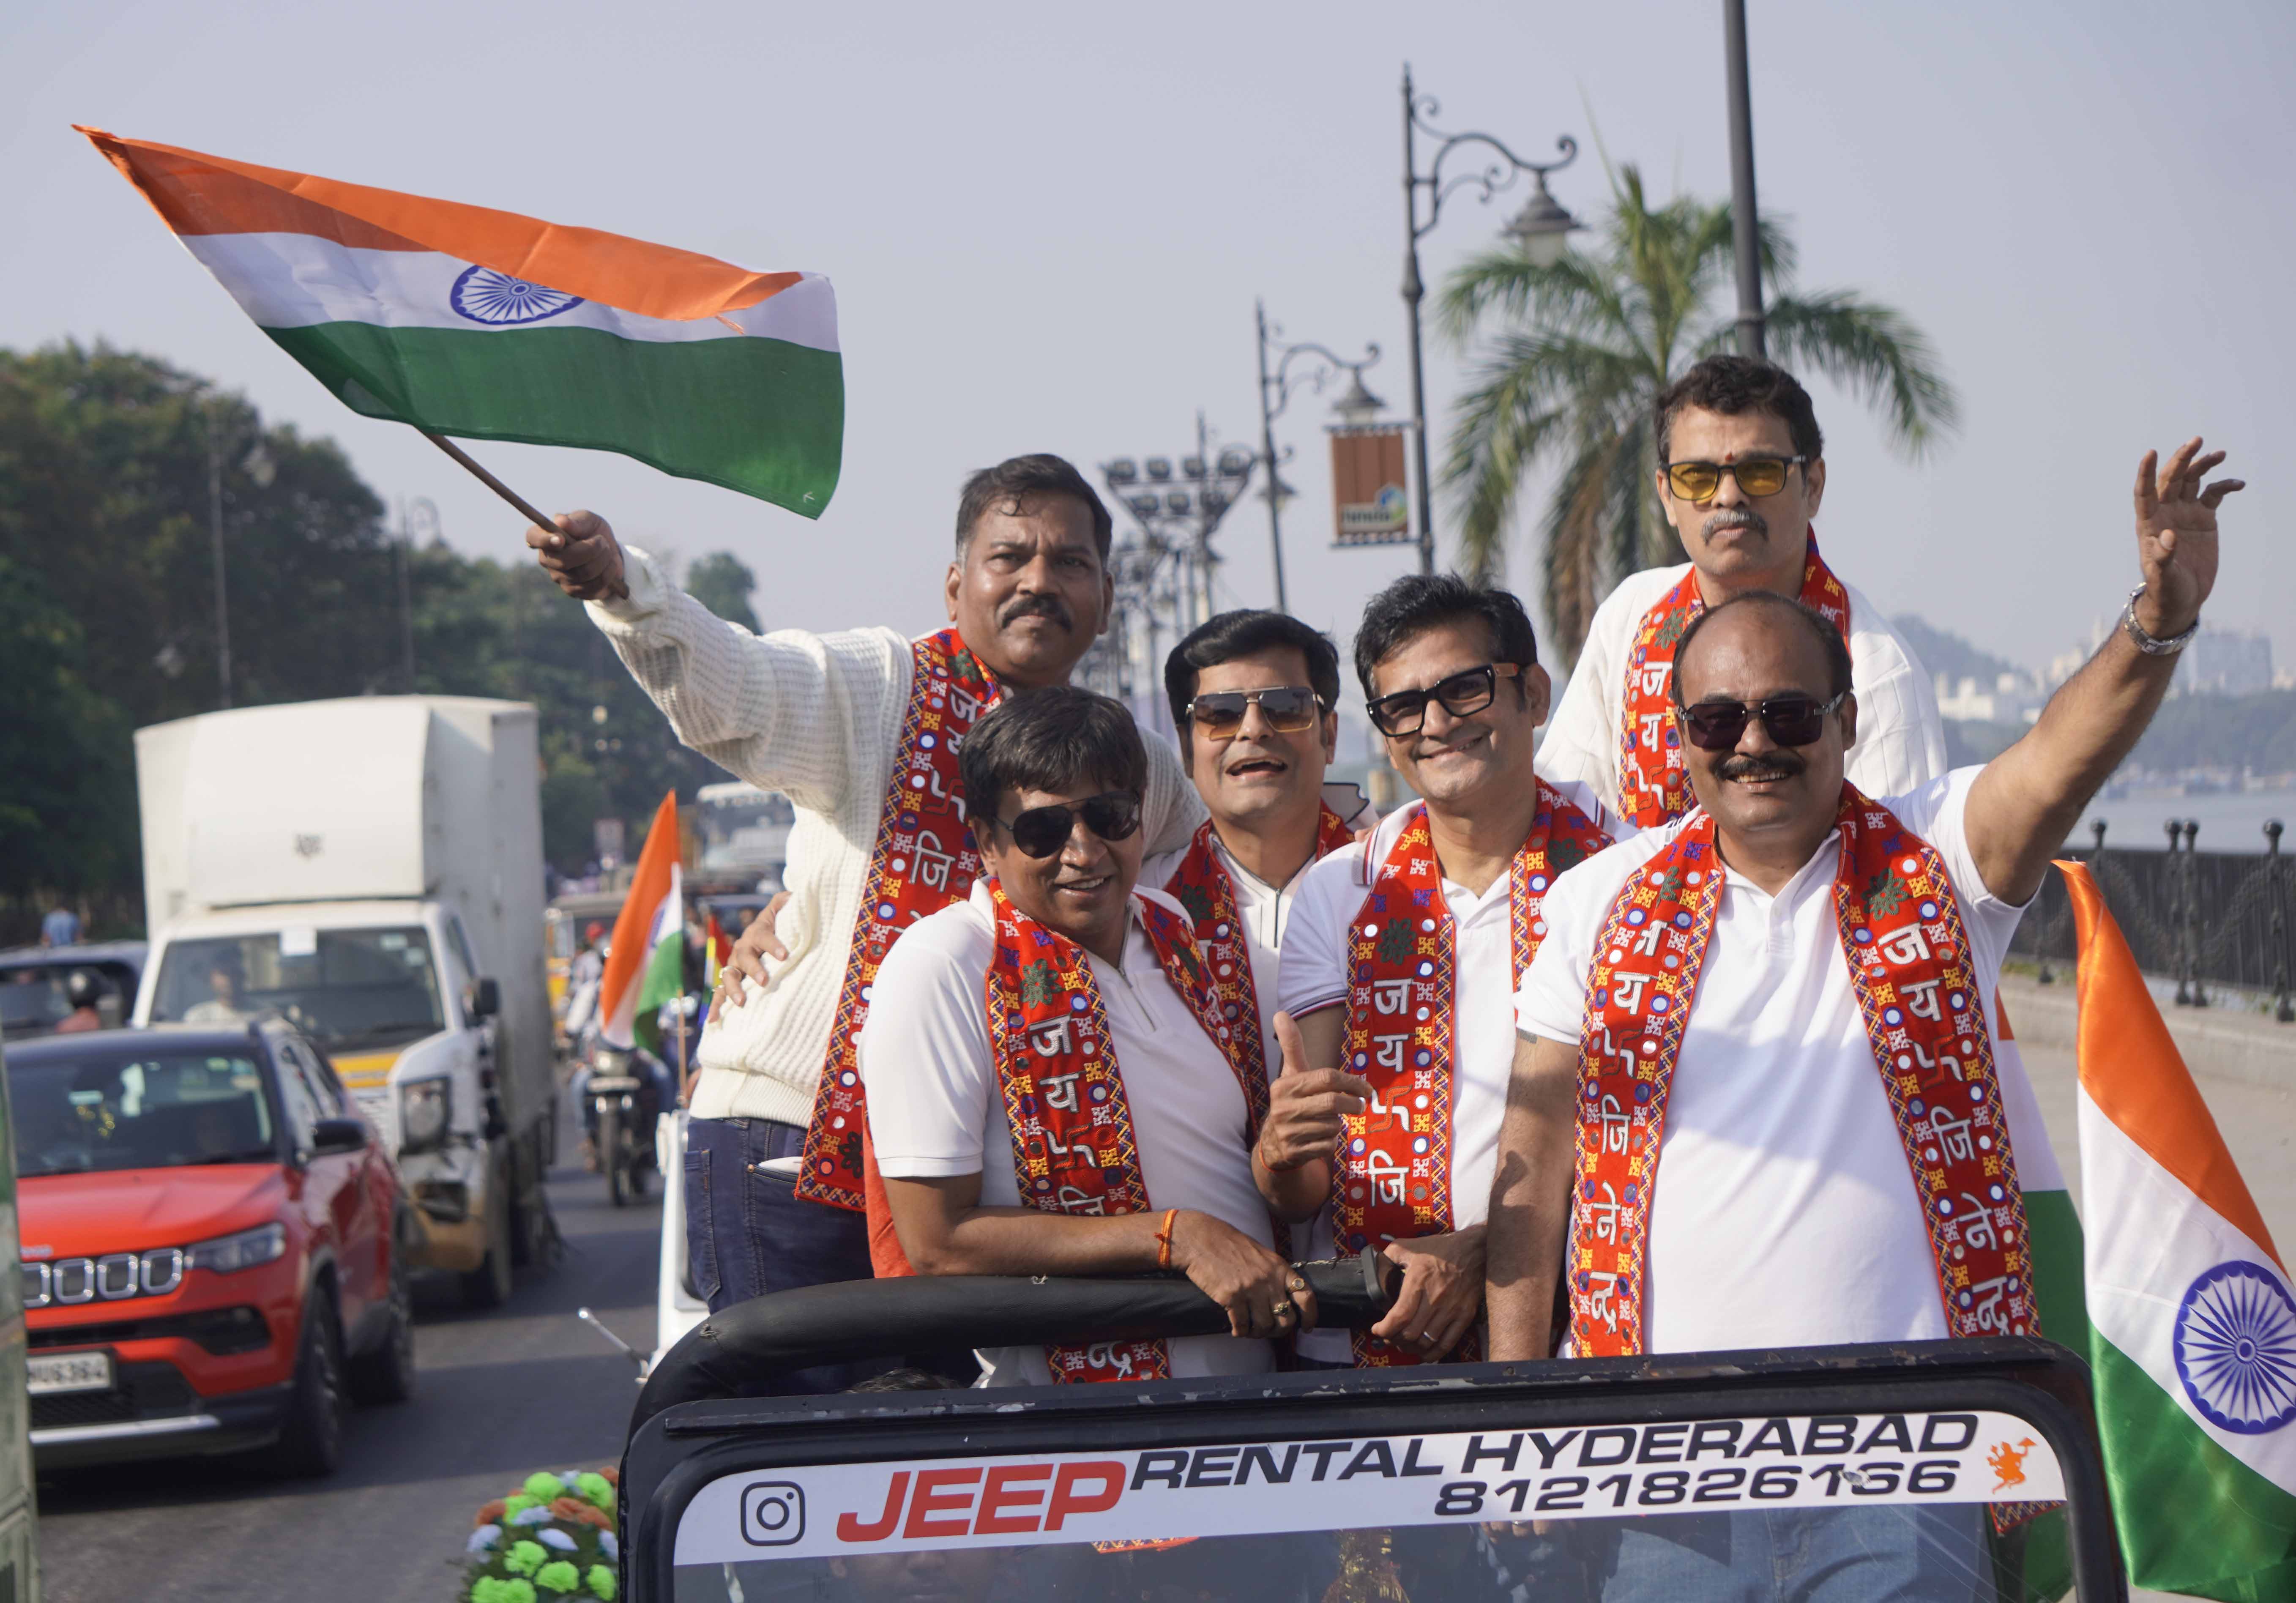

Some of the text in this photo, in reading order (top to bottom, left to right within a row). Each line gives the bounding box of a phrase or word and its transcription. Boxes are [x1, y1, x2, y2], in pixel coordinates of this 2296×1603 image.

[836, 1414, 1979, 1542] JEEP RENTAL HYDERABAD
[1433, 1460, 1960, 1515] 8121826166
